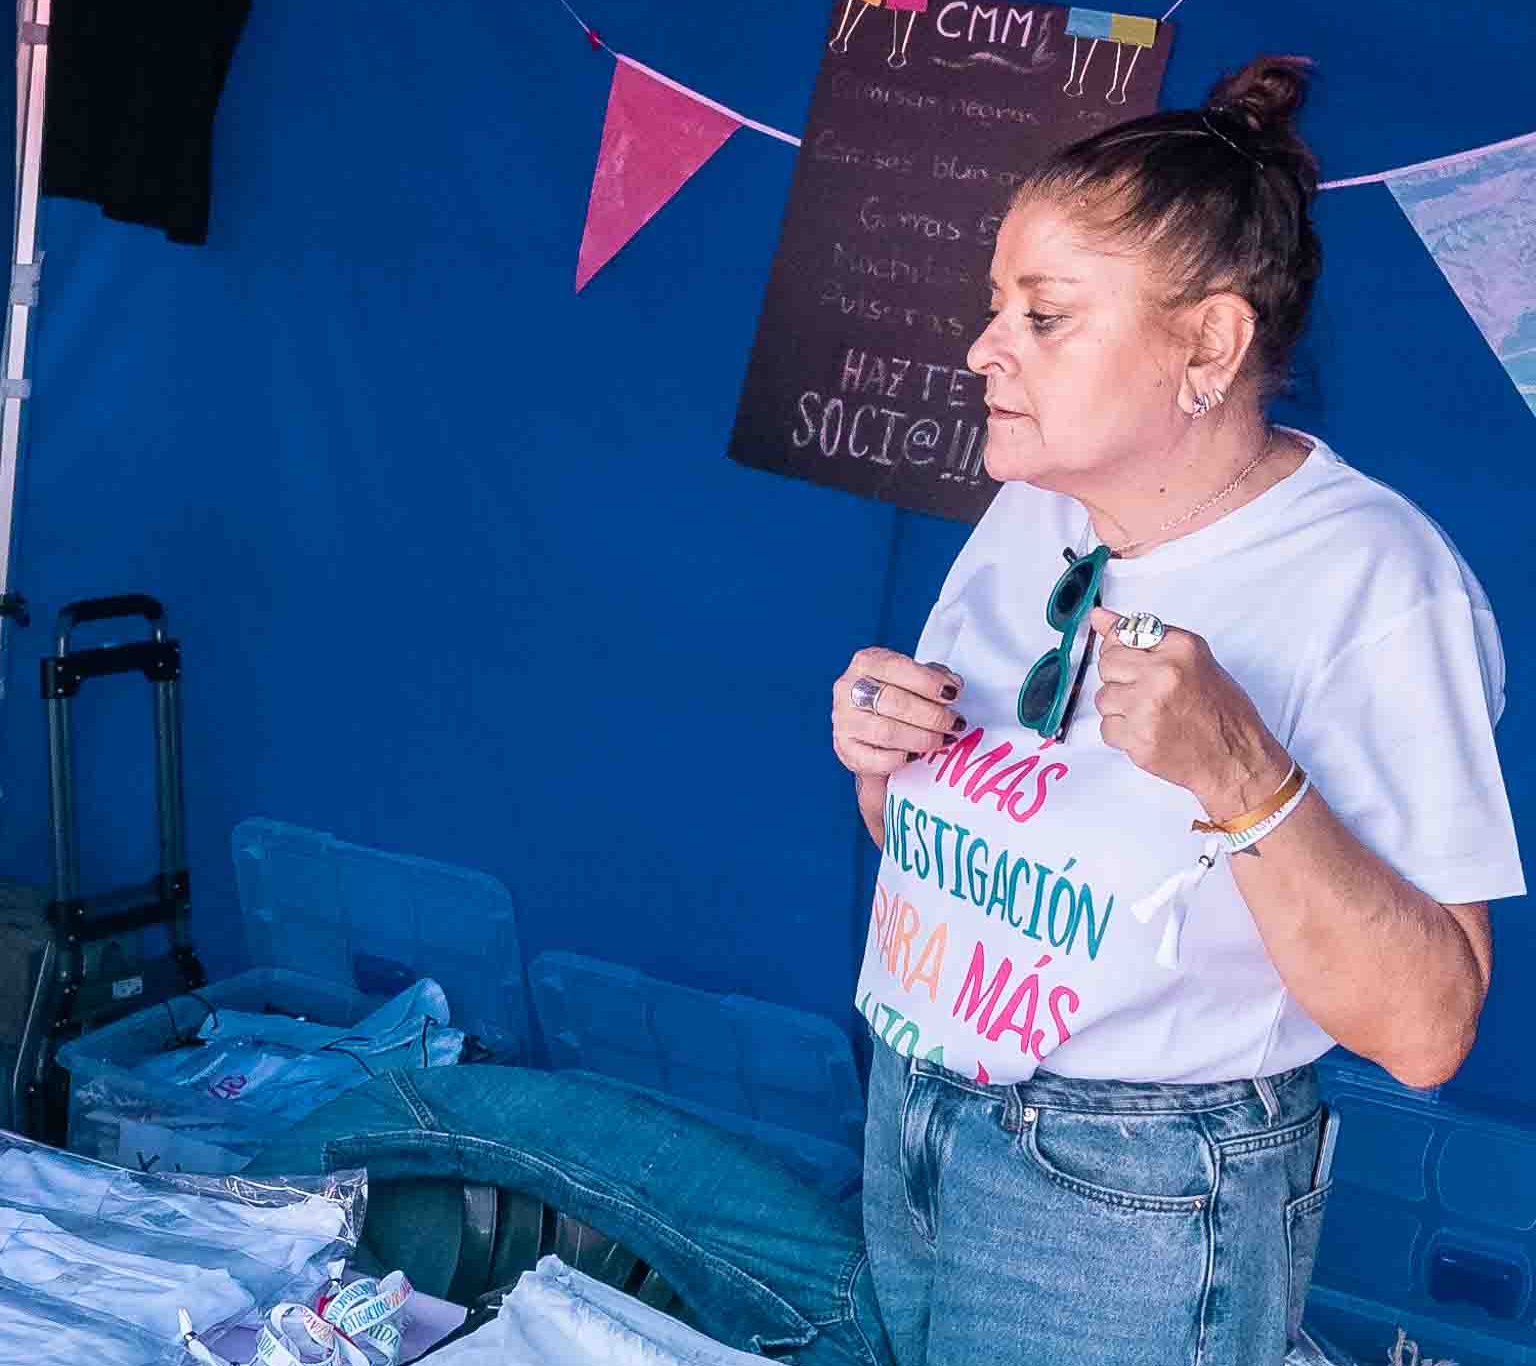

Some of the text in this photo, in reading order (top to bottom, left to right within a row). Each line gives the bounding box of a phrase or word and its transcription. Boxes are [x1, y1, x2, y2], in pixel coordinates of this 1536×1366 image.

[935, 0, 1033, 49] CMM
[926, 726, 1069, 823] MÁS
[952, 939, 1081, 1063] MÁS
